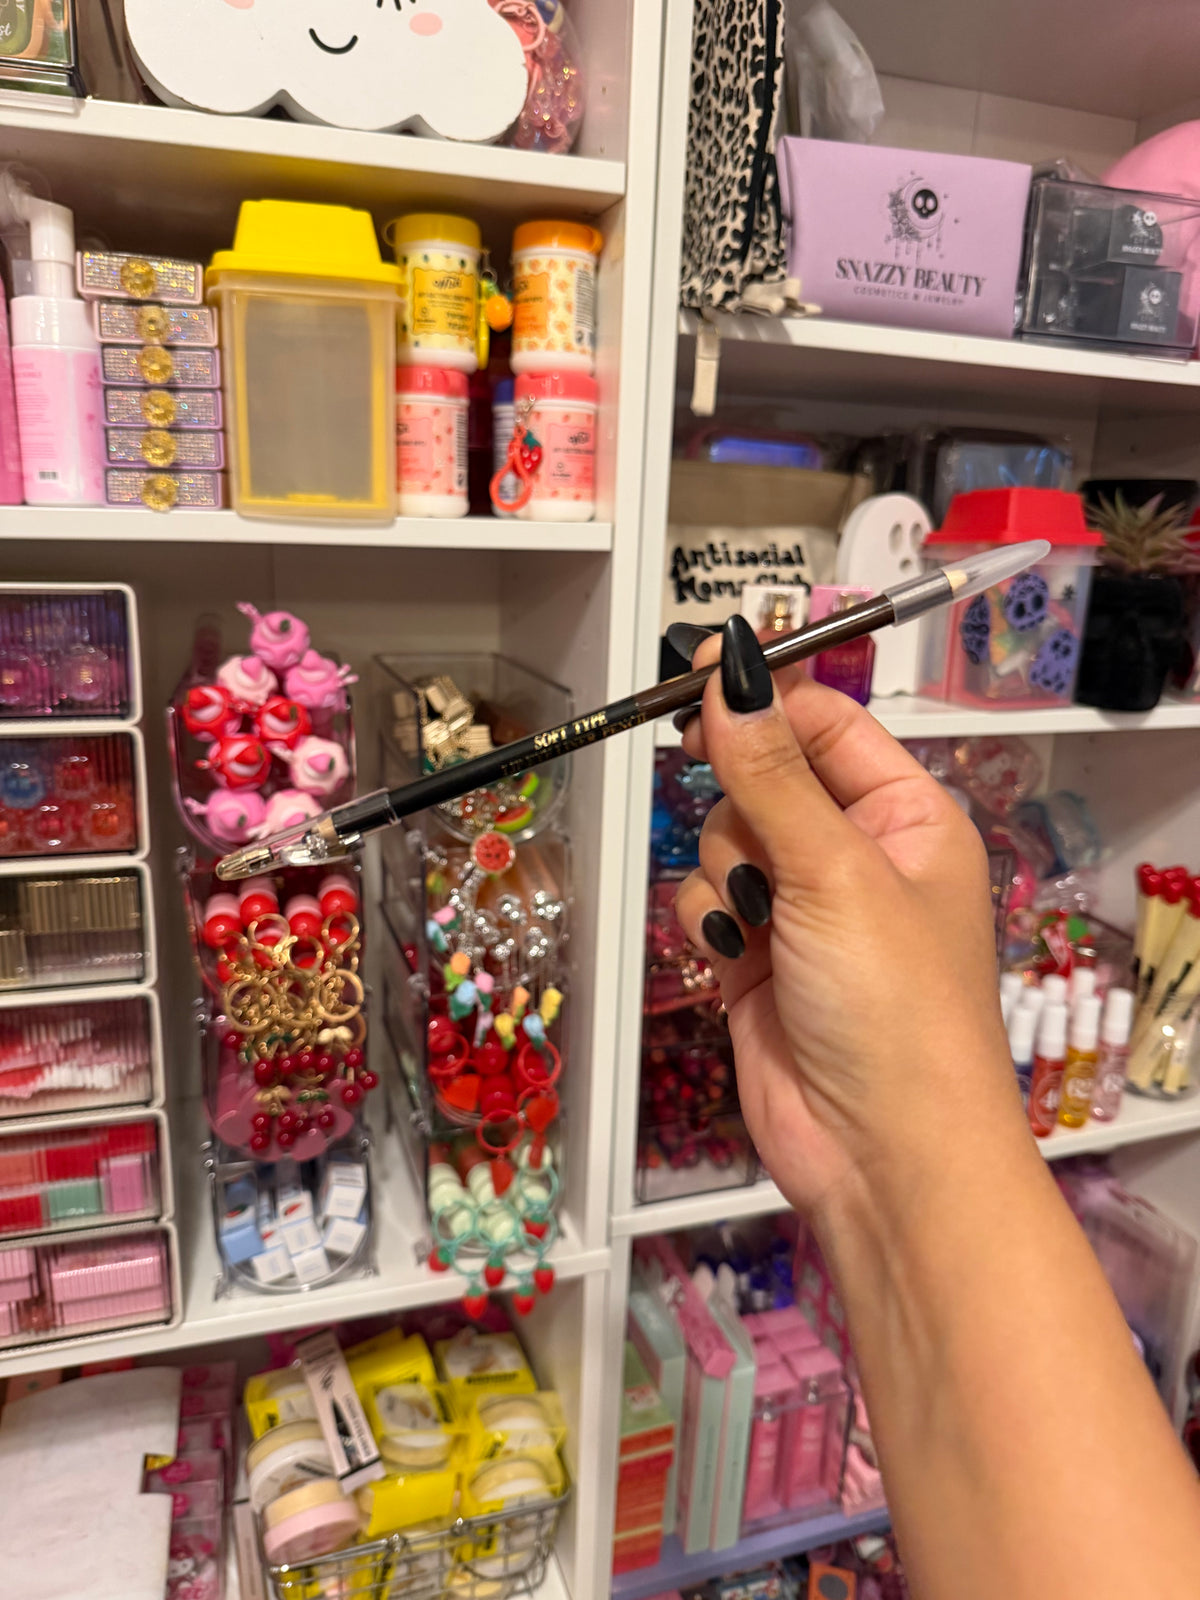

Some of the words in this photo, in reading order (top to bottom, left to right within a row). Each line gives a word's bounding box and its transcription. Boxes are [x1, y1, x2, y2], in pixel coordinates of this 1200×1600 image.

[835, 258, 911, 287] SNAZZY
[914, 268, 987, 297] BEAUTY
[671, 543, 805, 580] Antisocial
[534, 726, 568, 750] SOFT
[572, 710, 608, 735] TYPE
